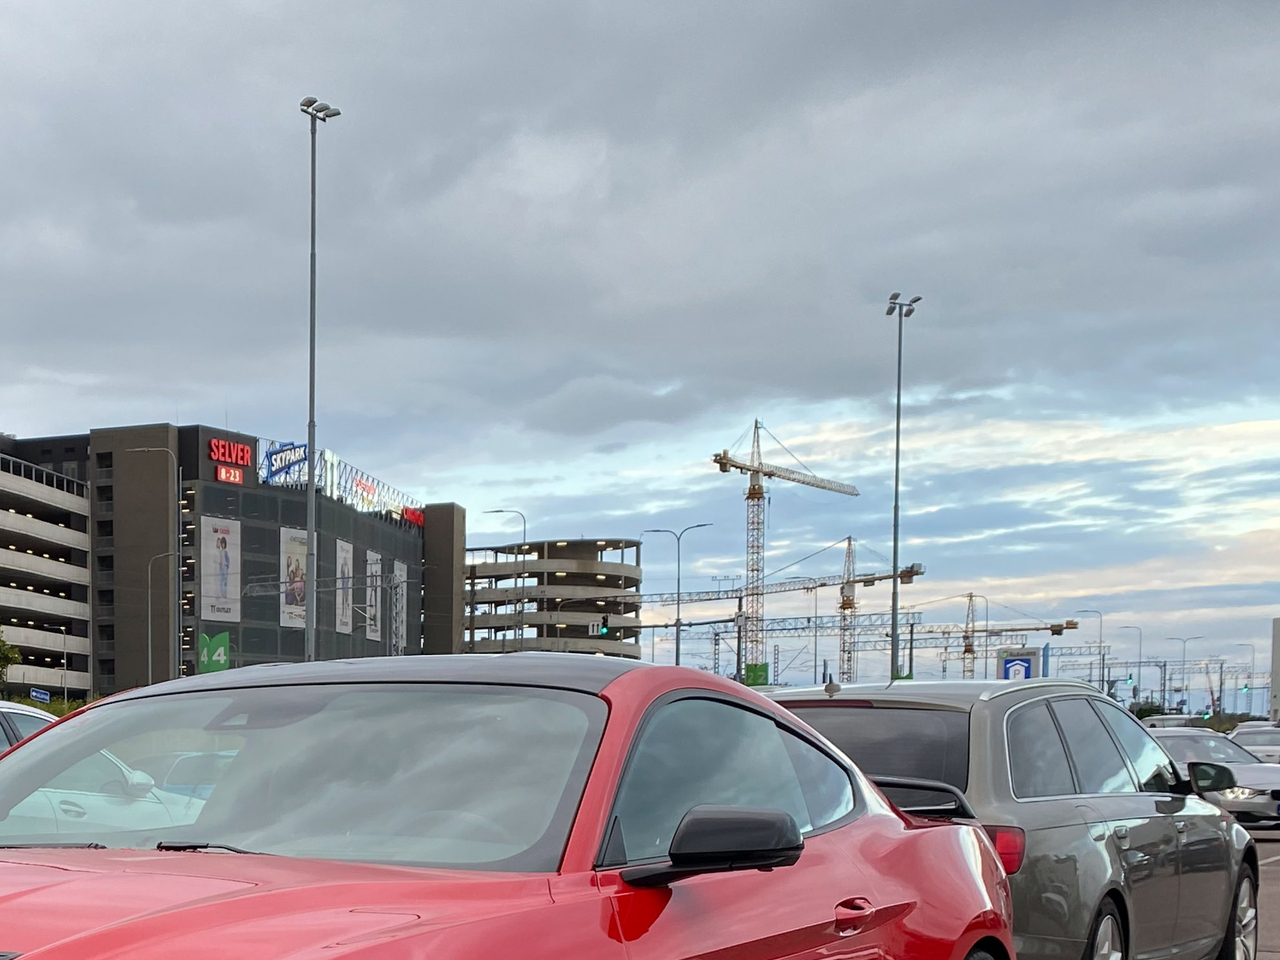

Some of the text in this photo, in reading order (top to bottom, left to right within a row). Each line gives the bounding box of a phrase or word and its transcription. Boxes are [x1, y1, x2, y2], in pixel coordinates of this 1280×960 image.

[210, 438, 251, 466] SELVER
[271, 446, 305, 472] SKYPARK
[201, 647, 208, 664] 4
[212, 646, 227, 664] 4
[1013, 669, 1021, 679] P
